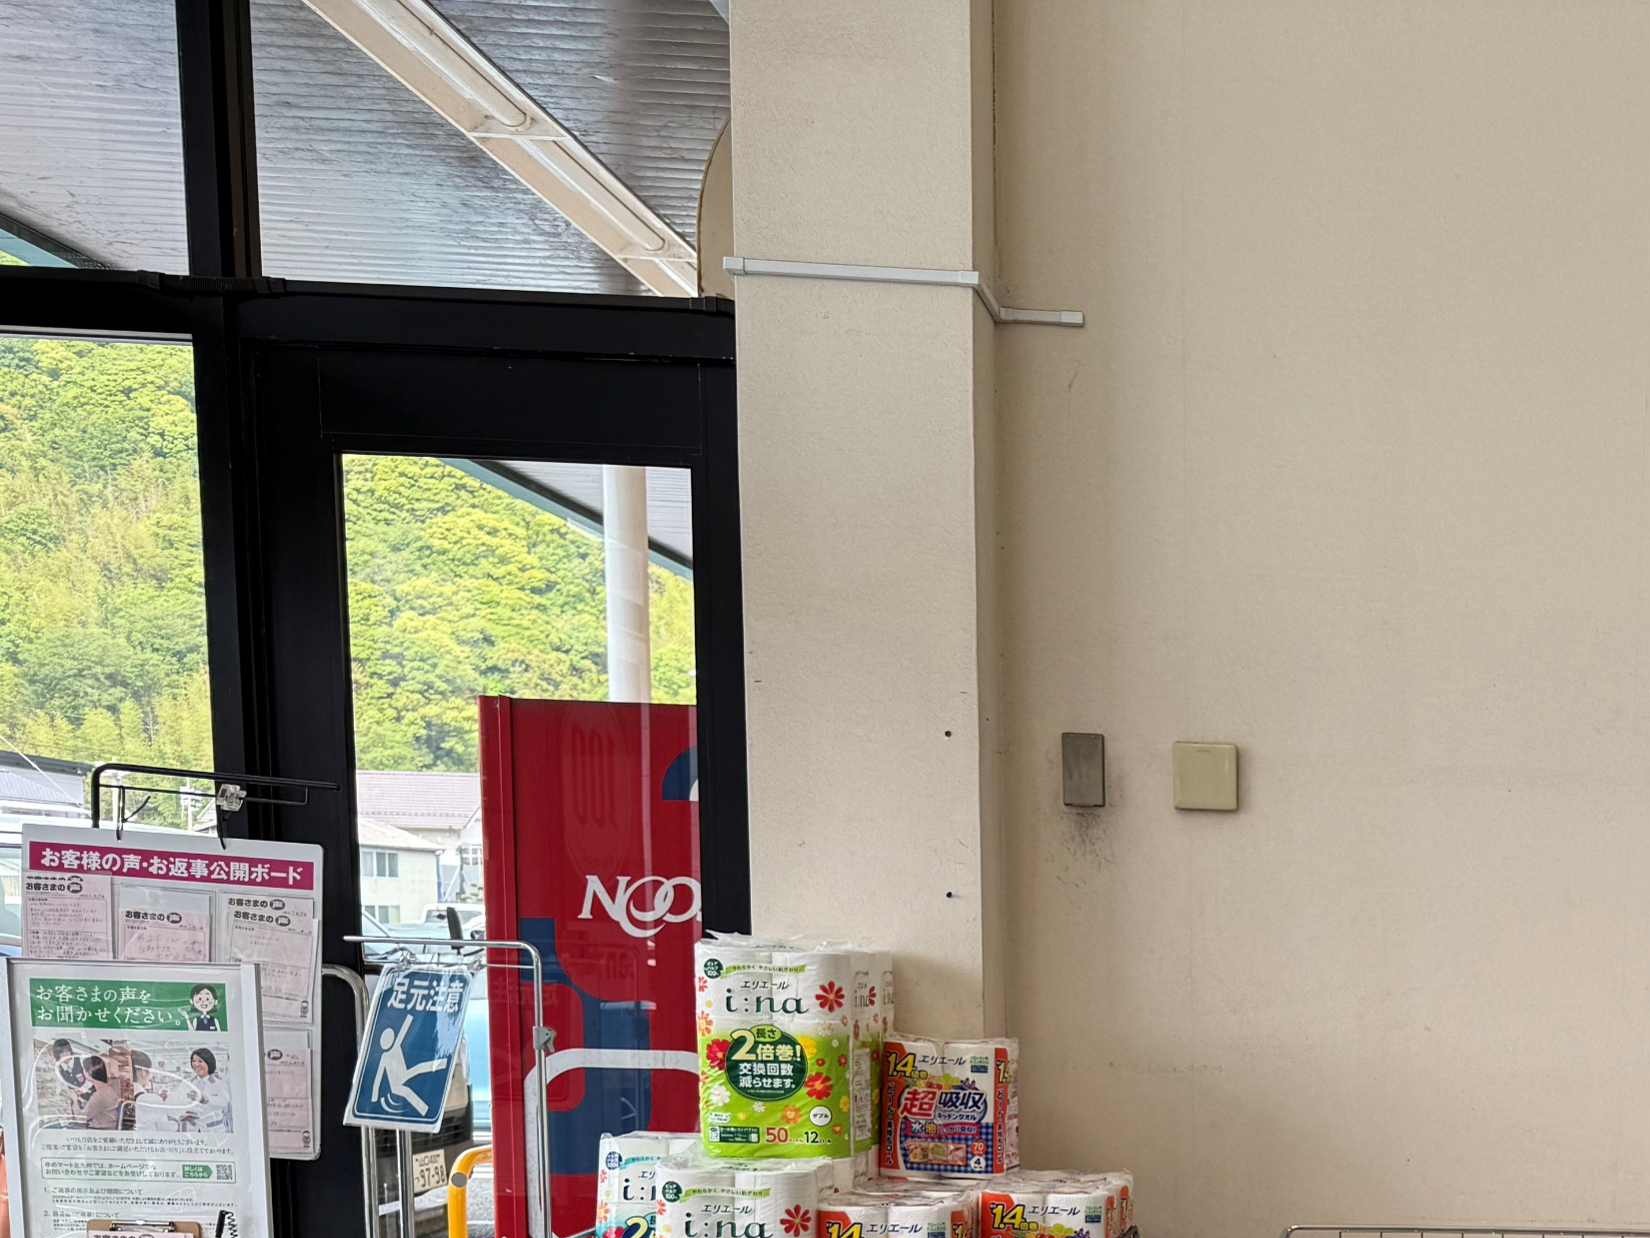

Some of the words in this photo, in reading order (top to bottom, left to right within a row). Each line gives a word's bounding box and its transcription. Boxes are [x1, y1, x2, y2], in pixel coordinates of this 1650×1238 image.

[41, 848, 303, 886] お客様の声・お返事公開ボード
[741, 980, 789, 990] エリエール
[37, 985, 151, 1004] お客さまの声を
[388, 978, 463, 1013] 足元注意
[37, 1006, 181, 1027] お聞かせください。
[756, 1028, 777, 1039] 長さ
[739, 1063, 794, 1077] 交換回数
[739, 1076, 797, 1089] 減らせます。
[937, 1112, 977, 1121] キッチンタオル
[701, 1204, 753, 1215] エリエール
